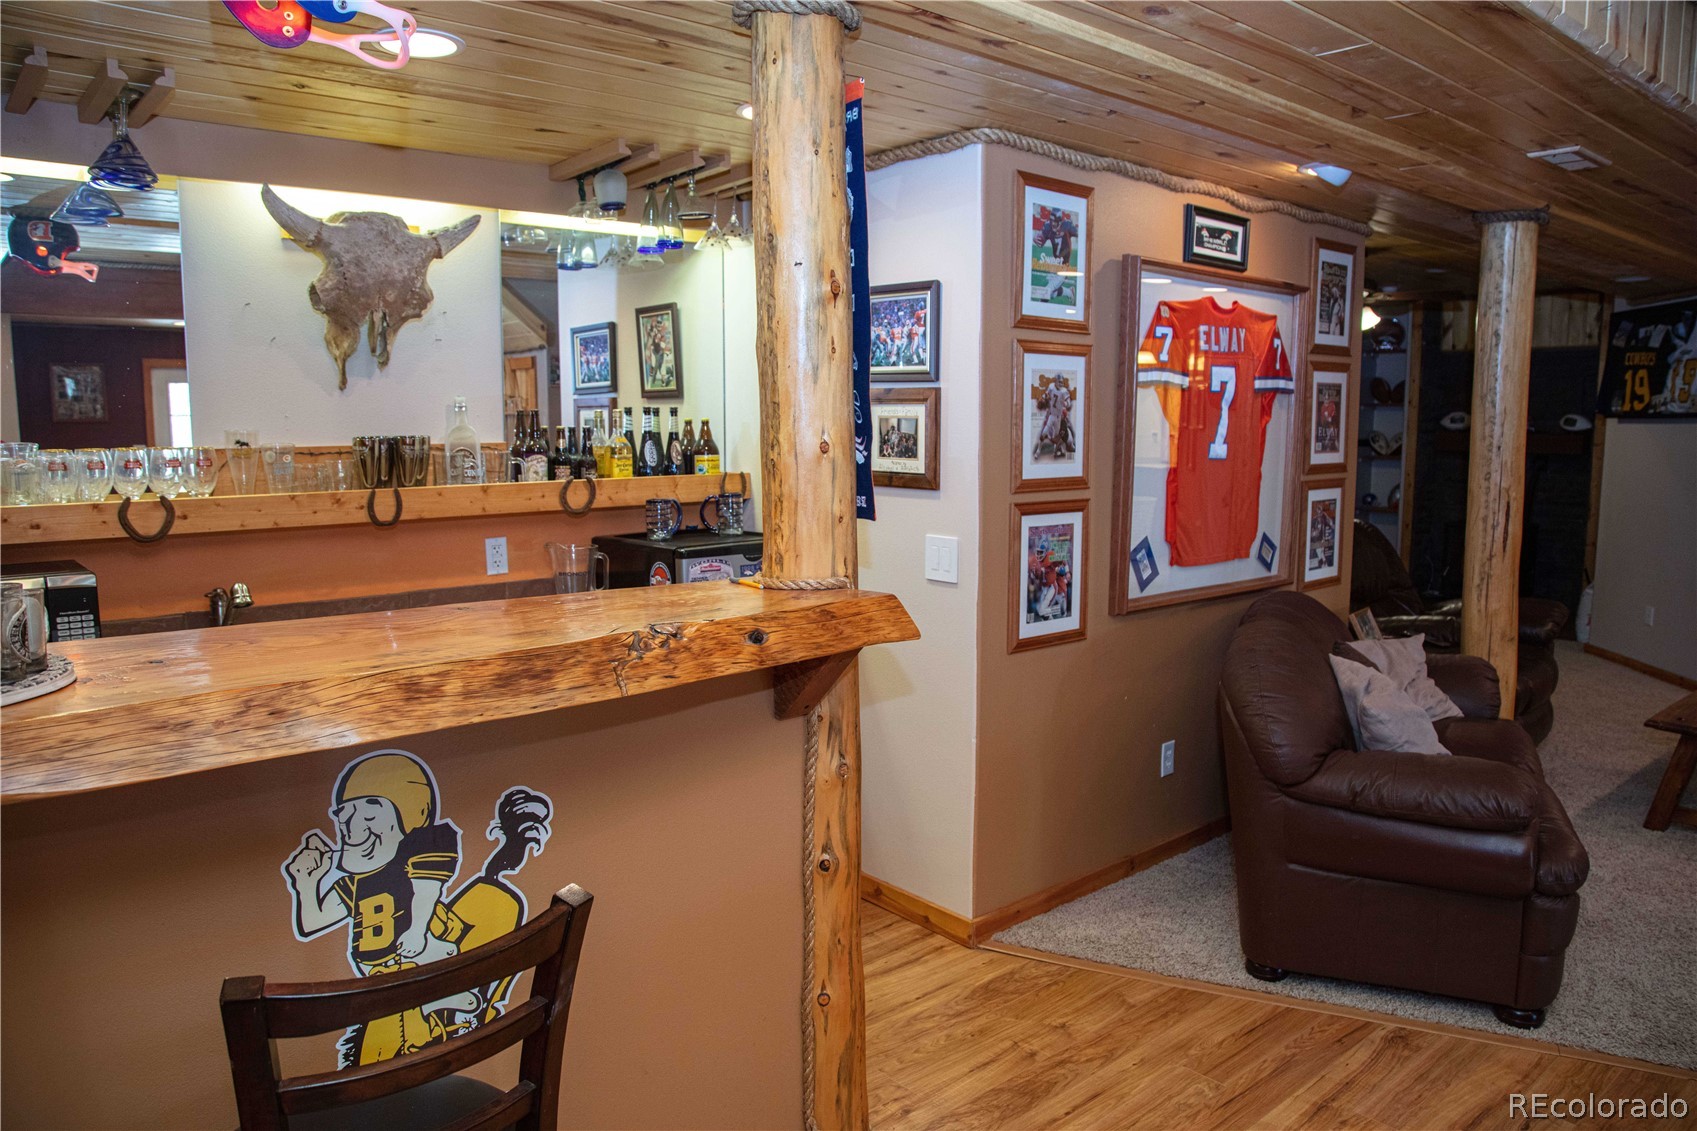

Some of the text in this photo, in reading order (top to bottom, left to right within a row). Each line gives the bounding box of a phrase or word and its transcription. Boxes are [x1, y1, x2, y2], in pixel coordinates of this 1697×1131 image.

[1040, 252, 1064, 265] Sweet
[1154, 325, 1174, 363] 7
[1199, 324, 1246, 353] ELWAY
[1273, 337, 1282, 371] 7
[1622, 369, 1651, 411] 19
[1208, 365, 1237, 460] 7
[359, 893, 395, 951] B
